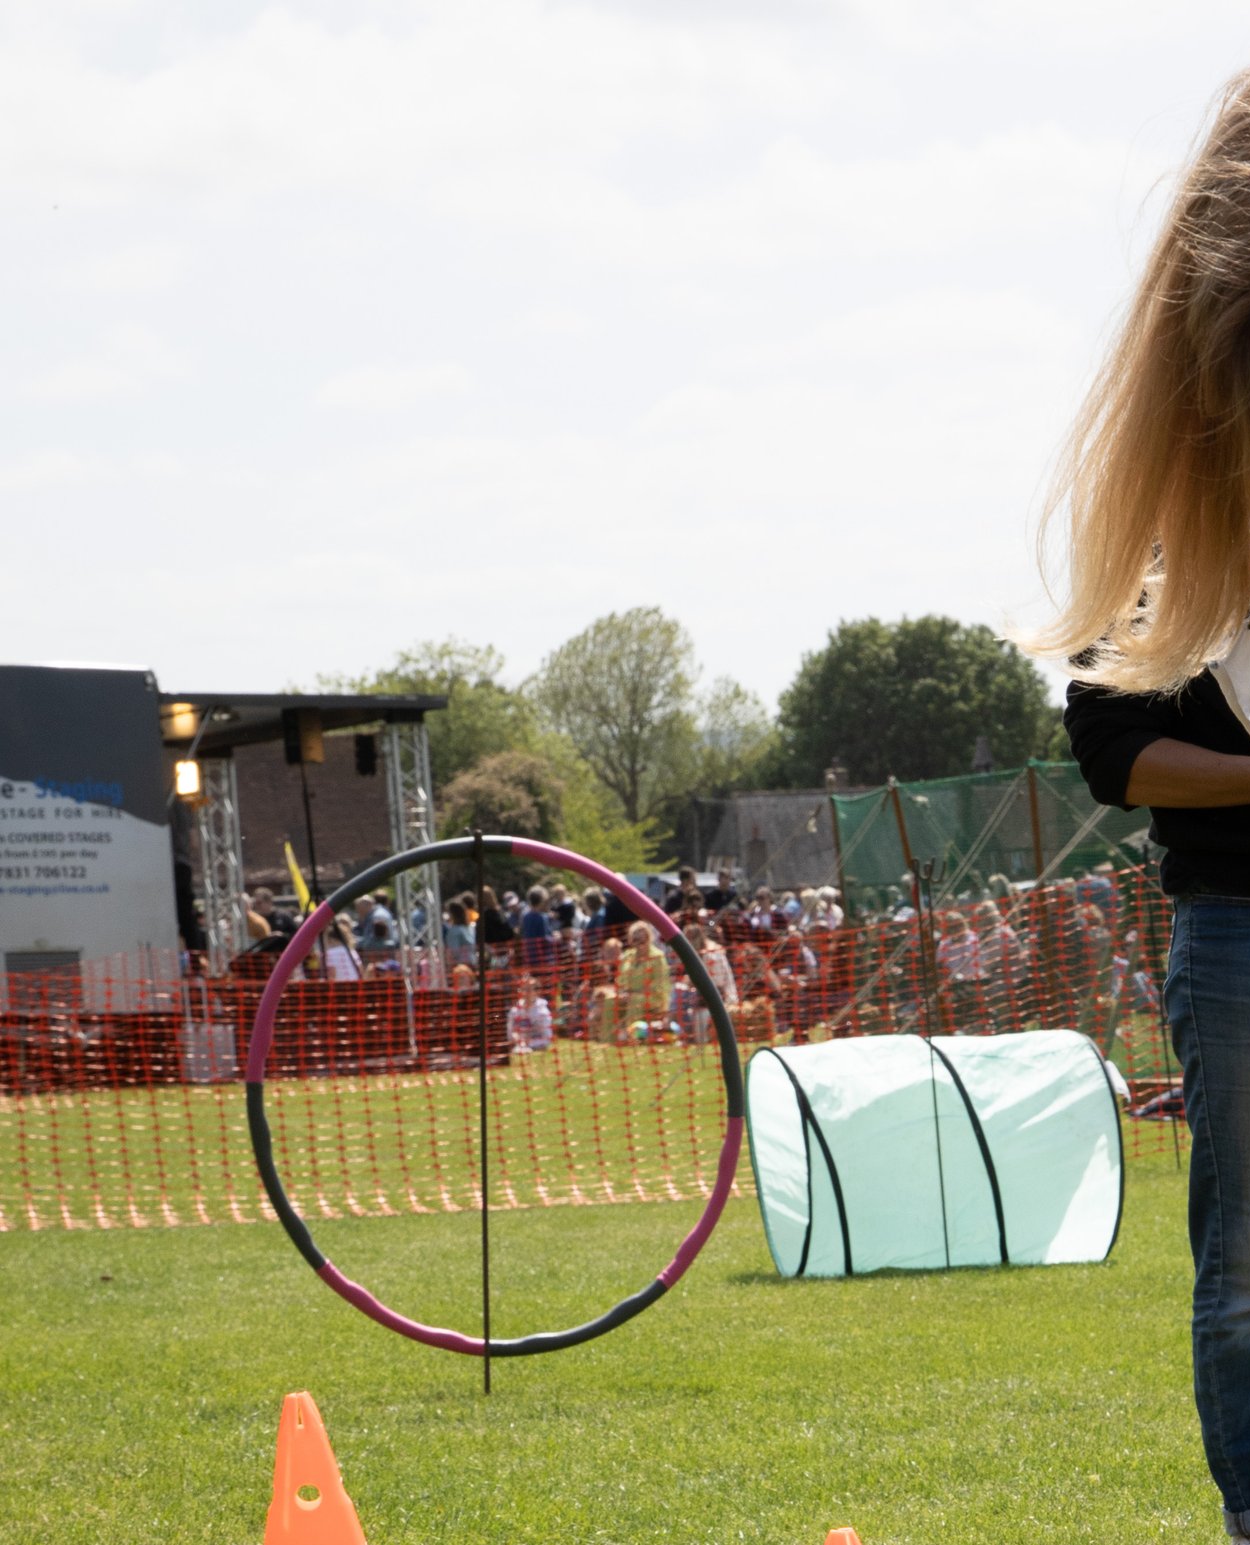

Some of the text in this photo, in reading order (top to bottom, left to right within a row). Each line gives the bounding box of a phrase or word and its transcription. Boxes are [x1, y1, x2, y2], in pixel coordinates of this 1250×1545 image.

[34, 777, 123, 805] Staging
[1, 807, 46, 819] STAGE
[54, 807, 84, 819] FOR
[8, 832, 65, 843] COVERED
[68, 832, 112, 843] STAGES
